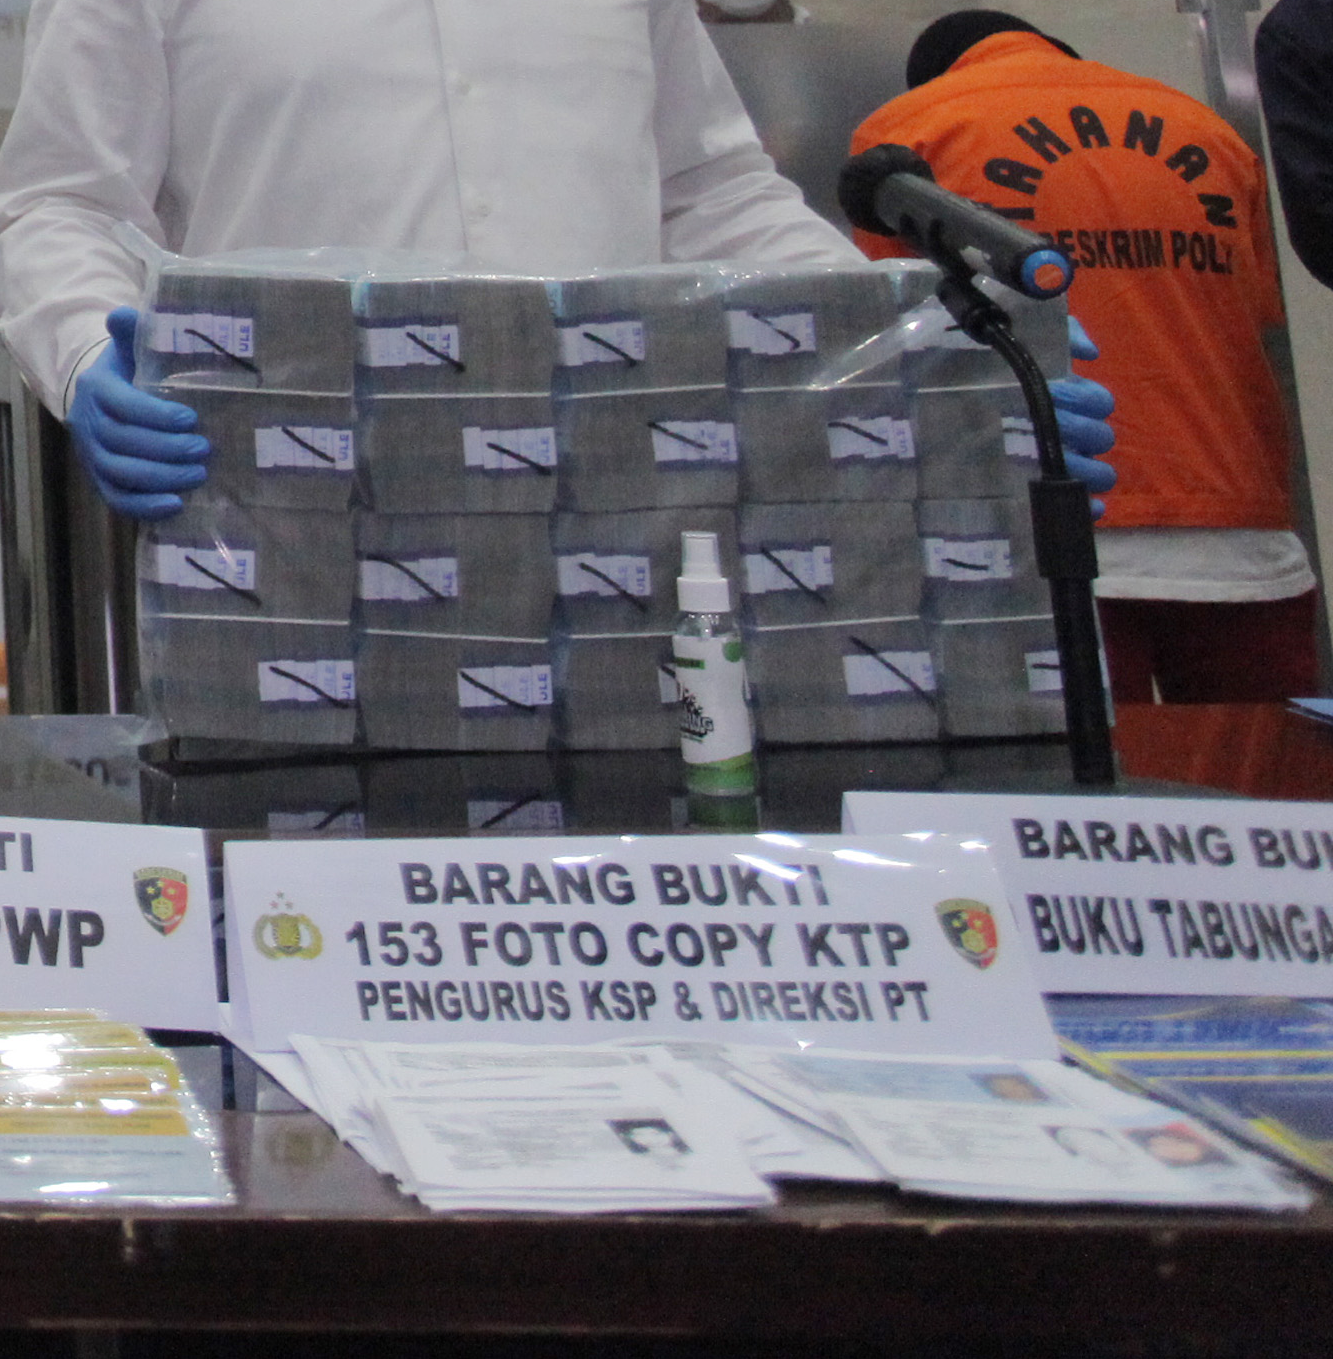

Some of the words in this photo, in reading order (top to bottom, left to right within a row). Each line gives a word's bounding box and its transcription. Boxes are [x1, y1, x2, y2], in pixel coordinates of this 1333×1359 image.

[973, 105, 1238, 229] TAHANAN
[1011, 817, 1236, 867] BARANG
[399, 862, 635, 906] BARANG
[654, 863, 829, 907] BUKTI
[345, 920, 444, 967] 153
[461, 921, 608, 967] FOTO
[626, 923, 776, 968] COPY
[799, 923, 911, 968] KTP
[1025, 893, 1146, 957] BUKU
[356, 980, 571, 1022] PENGURUS
[583, 981, 658, 1022] KSP
[674, 981, 702, 1022] &
[719, 981, 873, 1022] DIREKSI
[884, 982, 931, 1022] PT
